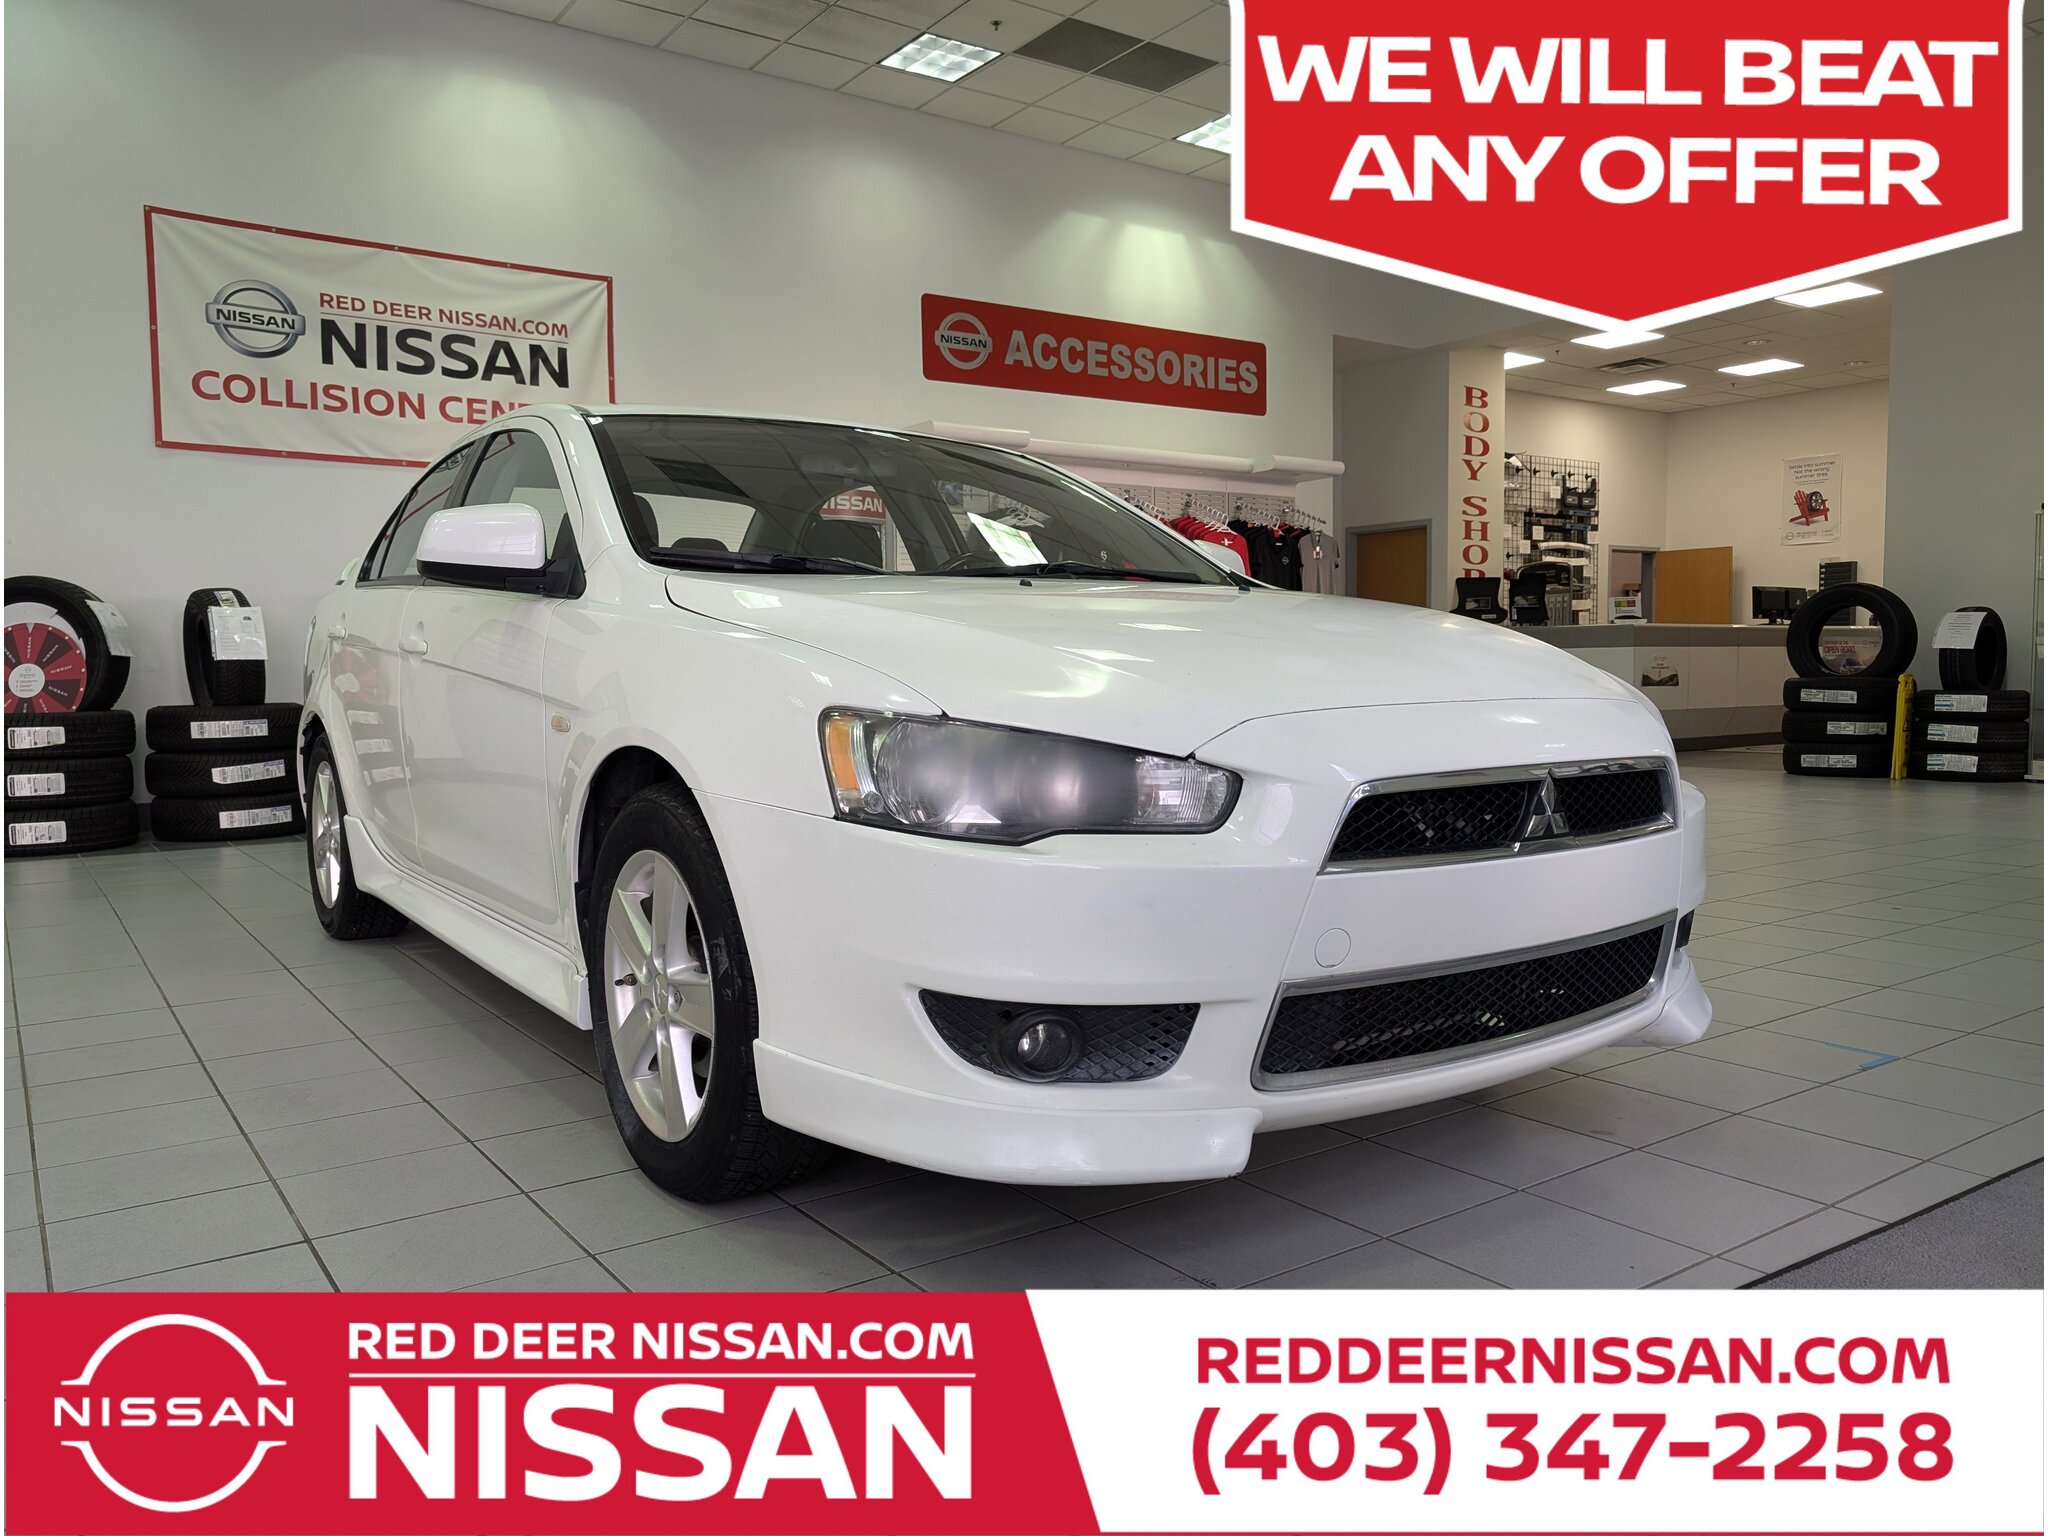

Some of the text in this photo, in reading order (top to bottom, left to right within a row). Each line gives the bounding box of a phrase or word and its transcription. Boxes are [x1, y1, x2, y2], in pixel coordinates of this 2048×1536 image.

[216, 308, 296, 331] NISSAN
[319, 292, 569, 338] RED DEER NISSAN.COM
[320, 318, 570, 389] NISSAN
[940, 329, 1259, 394] NISSAN ACCESSORIES
[191, 369, 531, 426] COLLISION CEN
[1461, 385, 1490, 482] BODY
